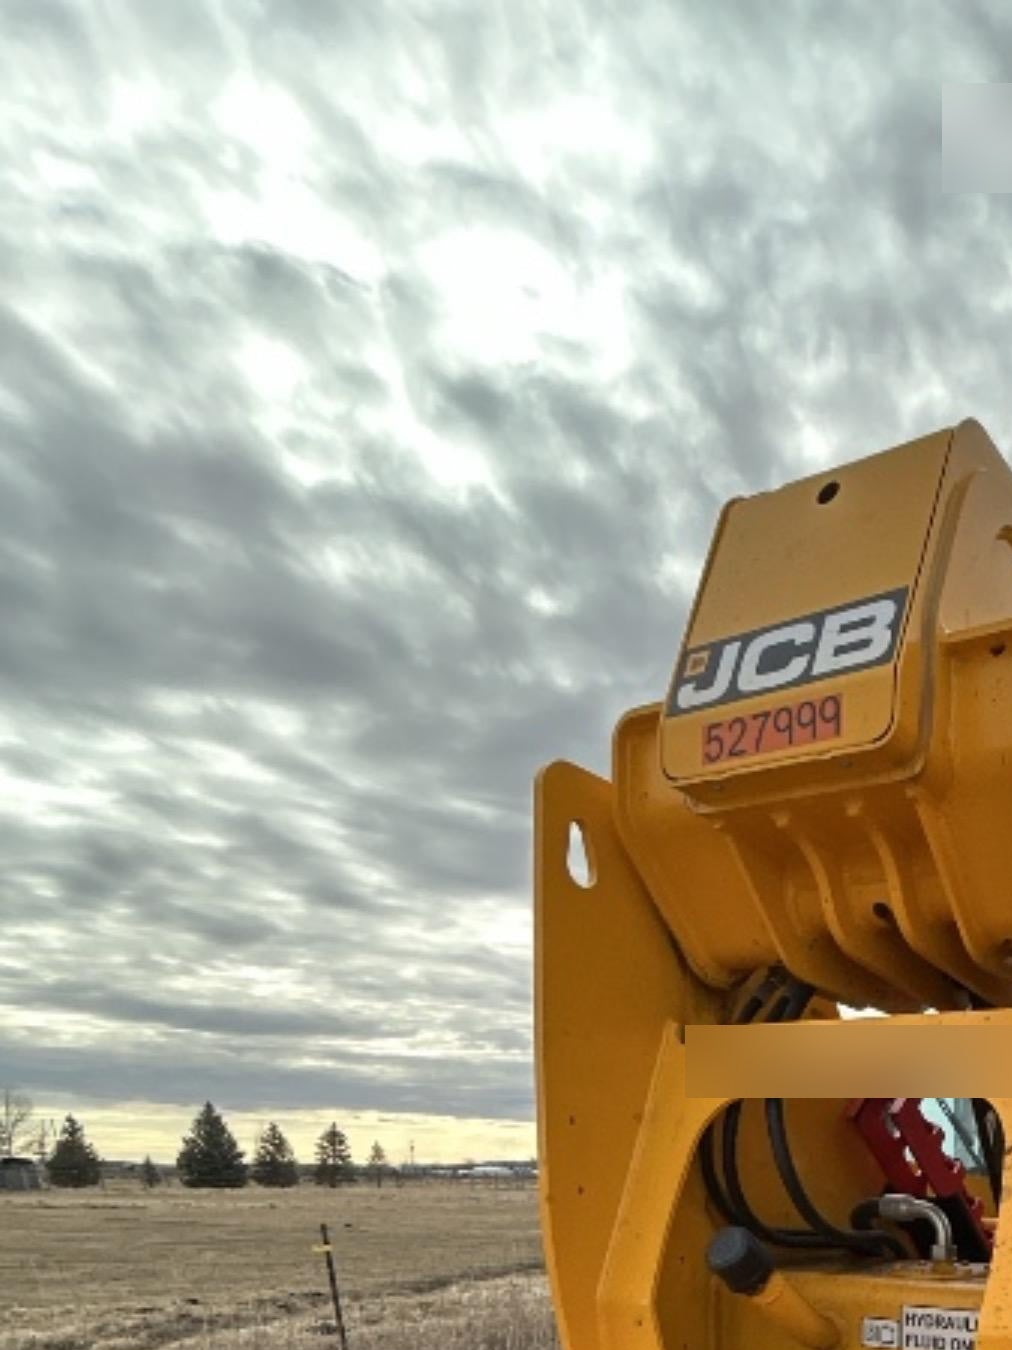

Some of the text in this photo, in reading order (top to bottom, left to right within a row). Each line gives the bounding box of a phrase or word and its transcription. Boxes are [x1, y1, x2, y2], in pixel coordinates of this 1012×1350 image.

[677, 599, 896, 709] JCB
[704, 695, 842, 763] 527999
[905, 1313, 979, 1332] HYDRAULI
